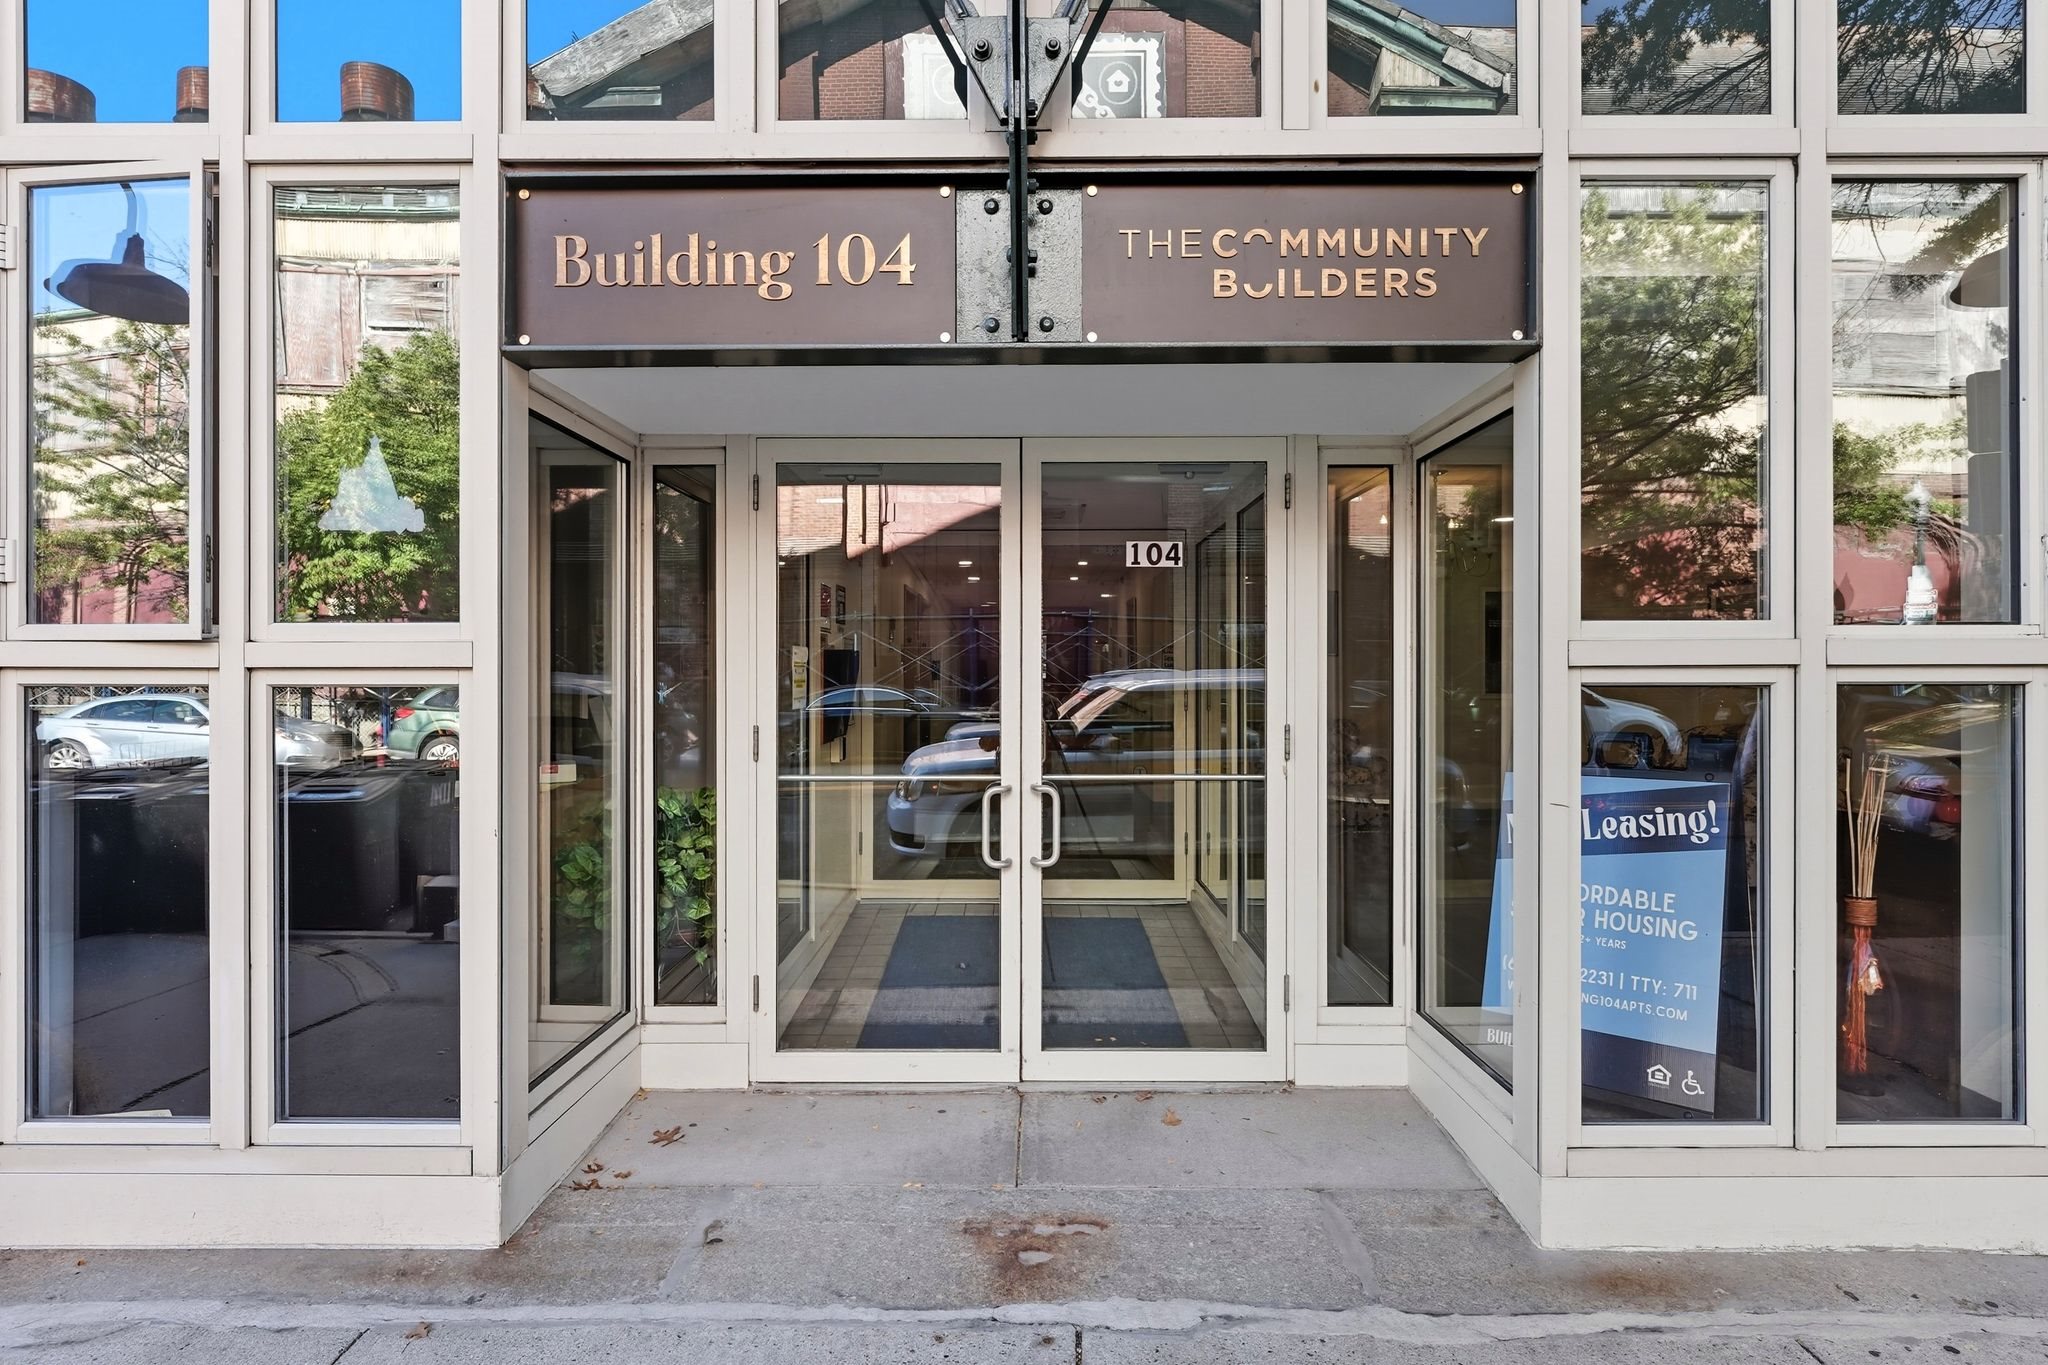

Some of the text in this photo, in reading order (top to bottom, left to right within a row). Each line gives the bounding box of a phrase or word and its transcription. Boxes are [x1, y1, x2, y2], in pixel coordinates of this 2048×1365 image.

[1119, 227, 1489, 258] THE COMMUNITY
[553, 232, 917, 301] Building 104
[1213, 268, 1438, 299] BUILDERS
[1130, 543, 1181, 566] 104
[1581, 800, 1720, 844] Leasing!
[1594, 909, 1698, 941] HOUSING
[1596, 937, 1626, 949] YEARS
[1631, 975, 1667, 995] TTY:
[1674, 982, 1697, 1001] 711
